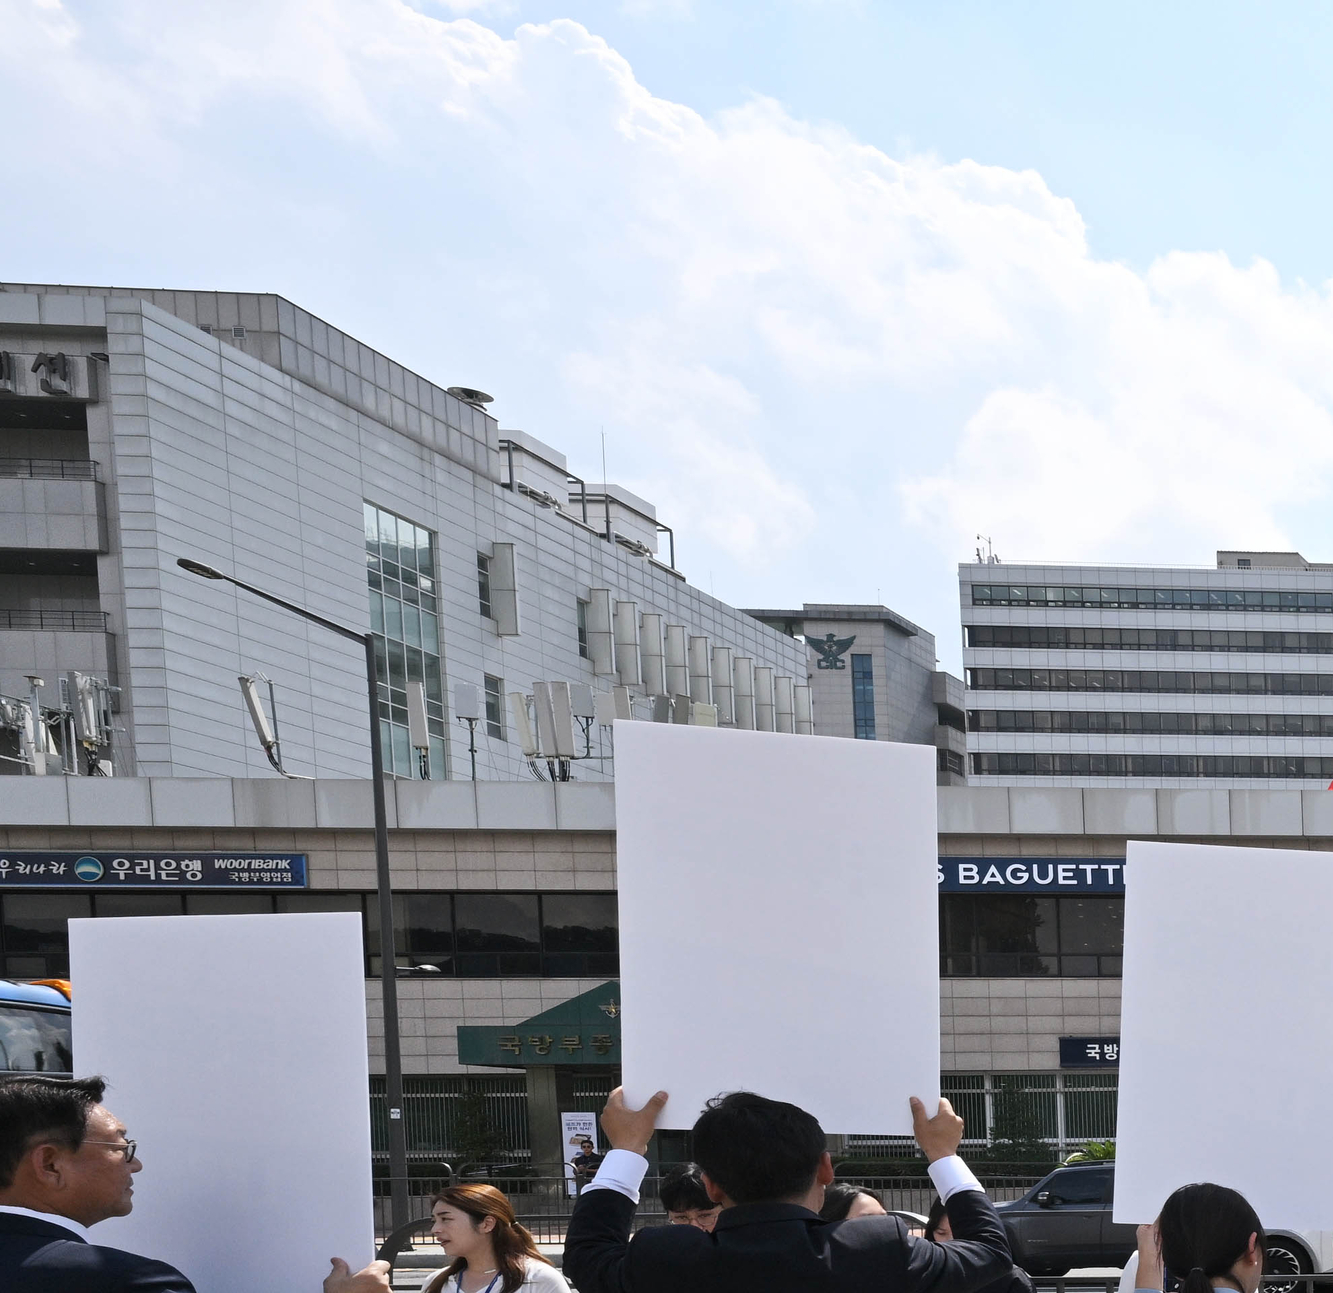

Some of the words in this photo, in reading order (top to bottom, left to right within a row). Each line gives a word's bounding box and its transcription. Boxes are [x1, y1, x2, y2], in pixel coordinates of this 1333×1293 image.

[0, 859, 68, 879] 우리나라
[110, 858, 203, 881] 우리은행
[228, 871, 292, 882] 국방부영업점
[958, 863, 1126, 885] BAGUETT
[498, 1034, 614, 1055] 국방부종
[1086, 1044, 1119, 1060] 국방
